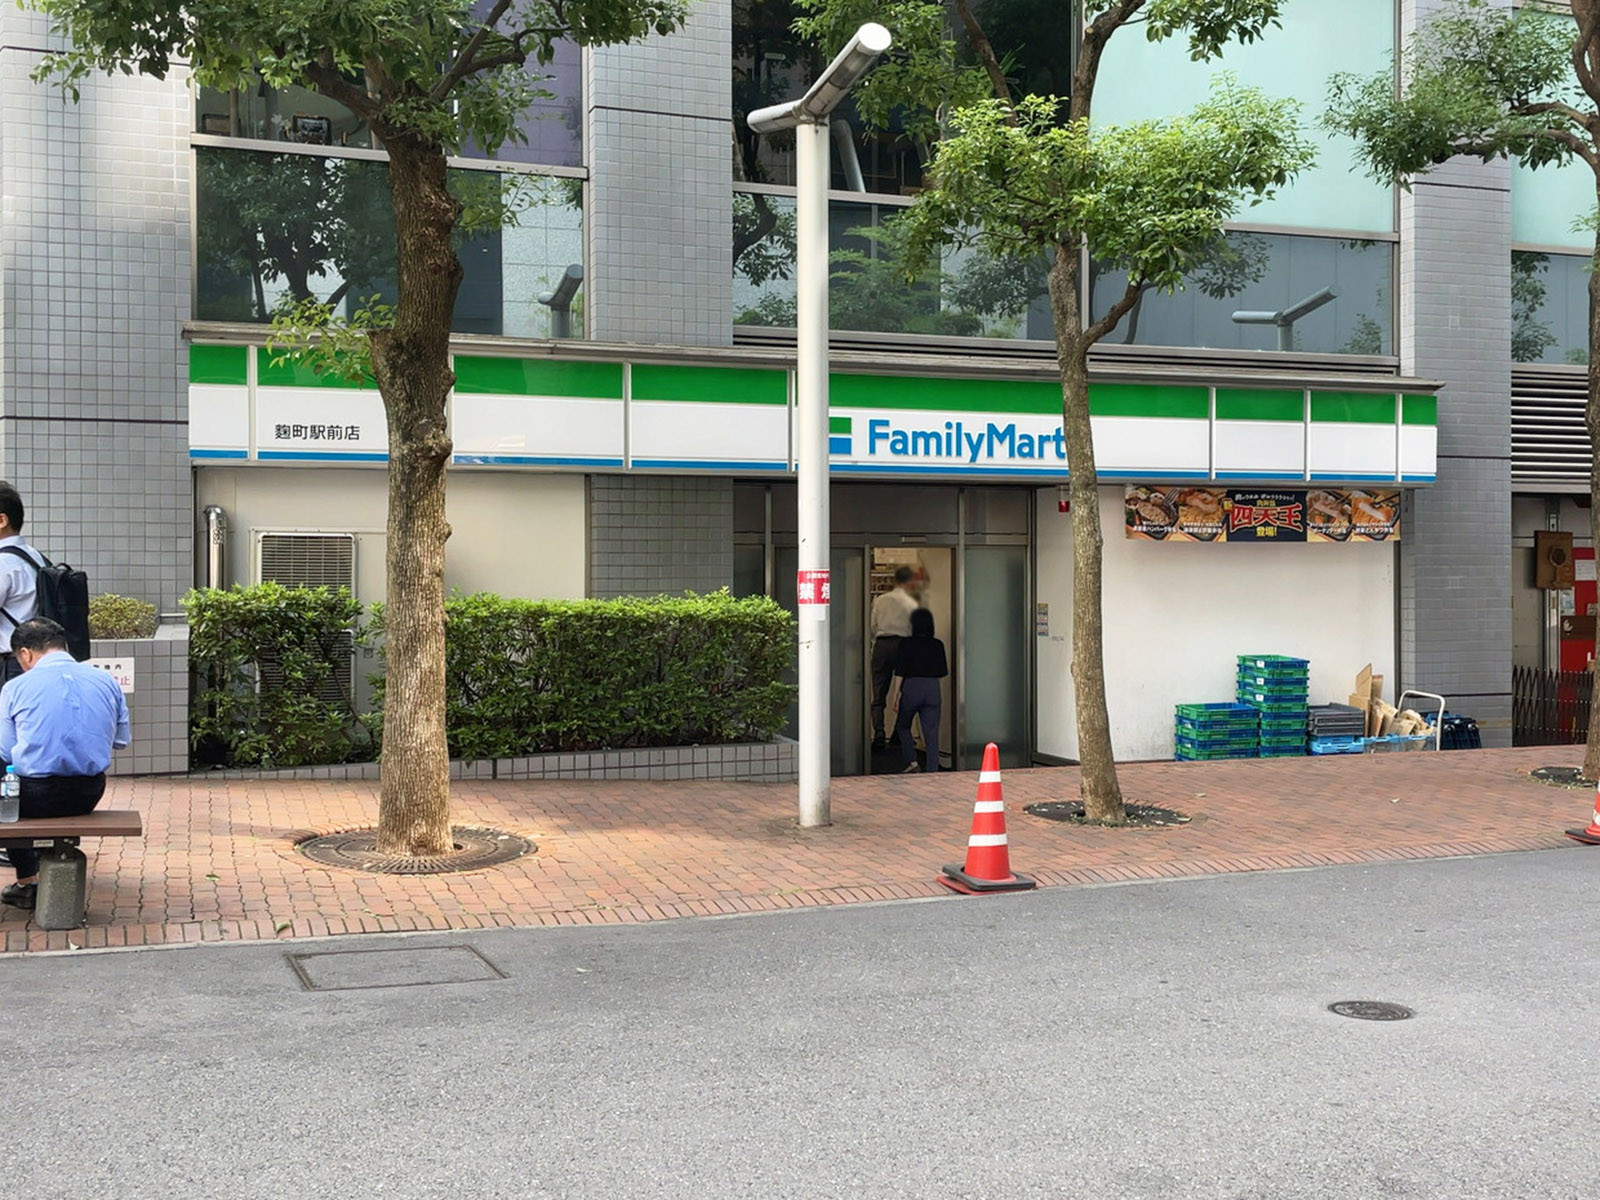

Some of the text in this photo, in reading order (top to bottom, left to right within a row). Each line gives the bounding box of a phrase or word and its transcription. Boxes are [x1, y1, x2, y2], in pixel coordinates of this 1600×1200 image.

[274, 424, 361, 441] 麹町駅前店
[867, 419, 1066, 463] FamilyMart
[1230, 503, 1303, 532] 四天王
